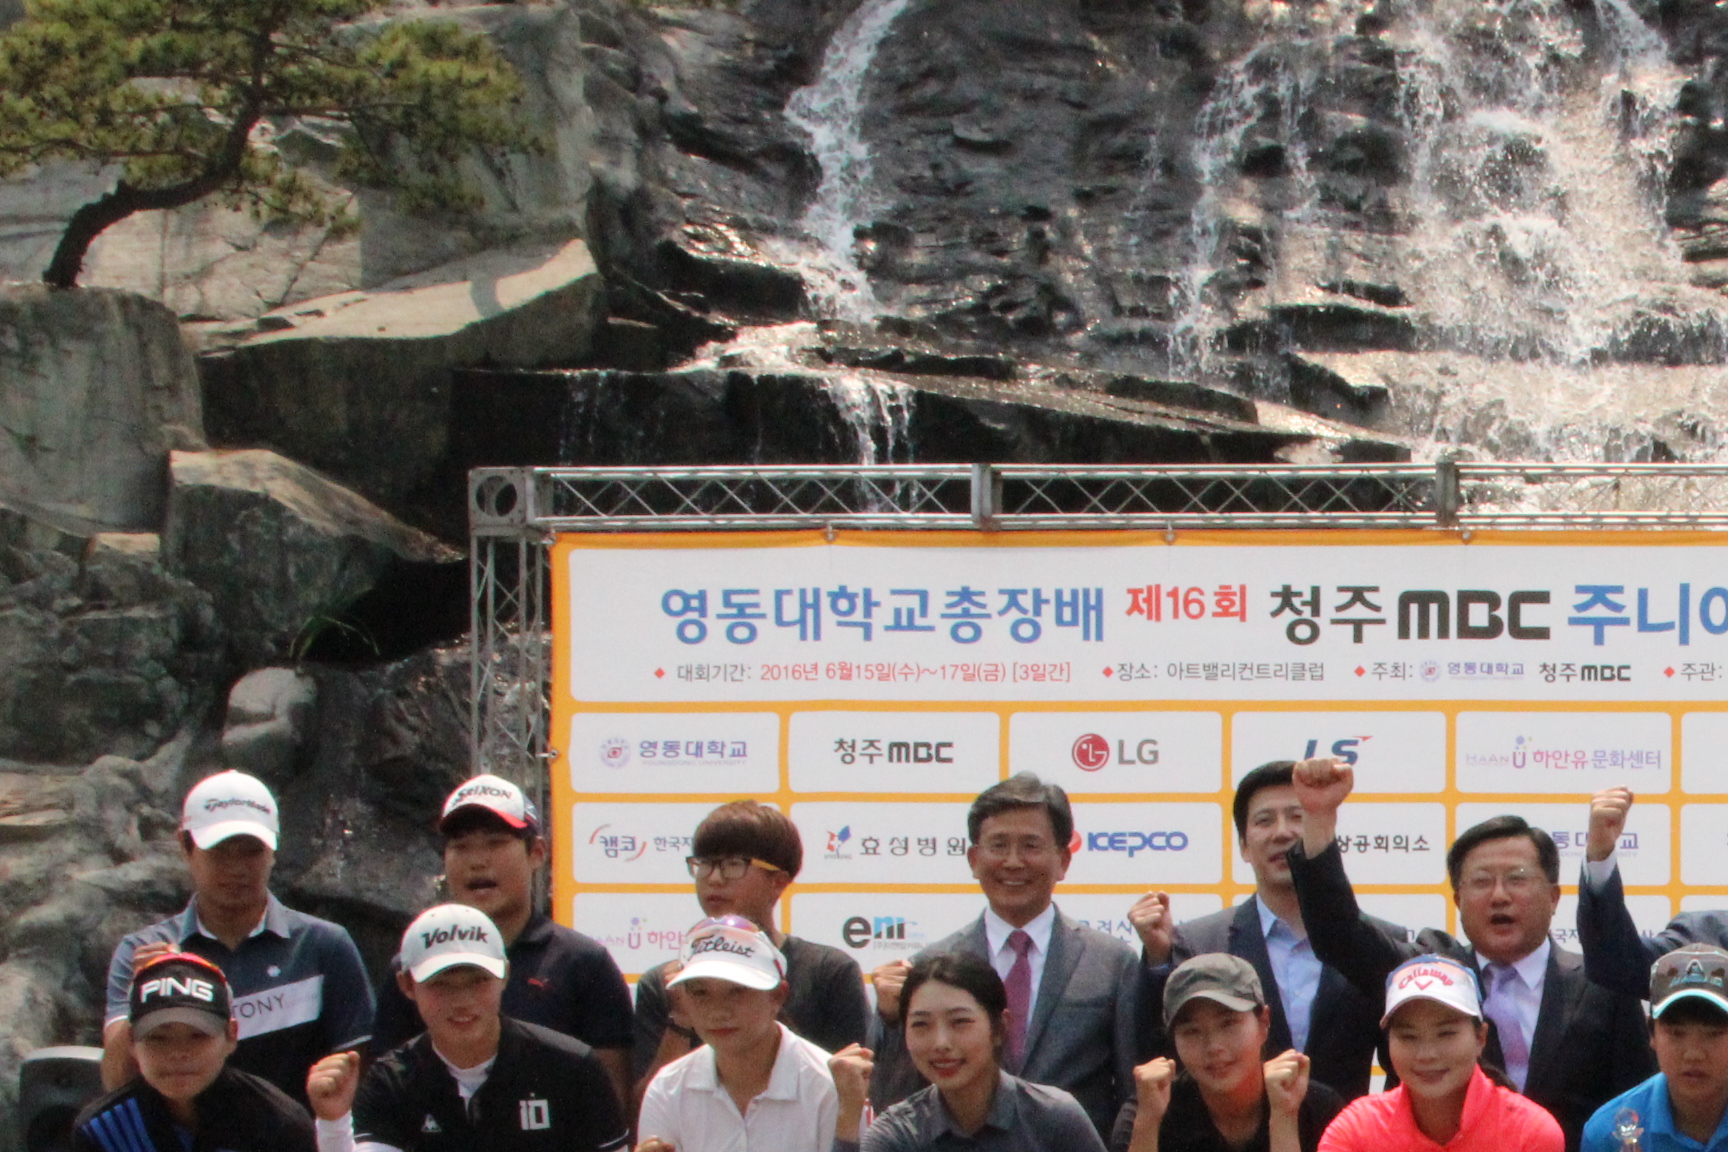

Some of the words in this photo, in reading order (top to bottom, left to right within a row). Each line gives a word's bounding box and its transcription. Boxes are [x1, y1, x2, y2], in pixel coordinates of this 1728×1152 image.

[661, 585, 1104, 645] 영동대학교총장배
[1125, 584, 1248, 623] 제16회
[677, 663, 752, 684] 대회기간:
[760, 663, 819, 683] 2016년
[1012, 661, 1071, 684] [3일간]
[1117, 661, 1158, 683] 장소:
[1167, 661, 1325, 683] 아트밸리컨트리클럽
[1371, 661, 1413, 682] 주최:
[1447, 661, 1525, 676] 영동대학교
[1681, 664, 1723, 683] 주관:
[640, 740, 748, 758] 영동대학교
[1117, 739, 1160, 765] LG
[599, 835, 636, 858] 캠코
[860, 836, 967, 857] 효성병원
[1088, 831, 1189, 858] KEPCO
[1337, 834, 1430, 853] 상공회의소
[421, 924, 489, 950] Volvik
[141, 977, 214, 1003] PING
